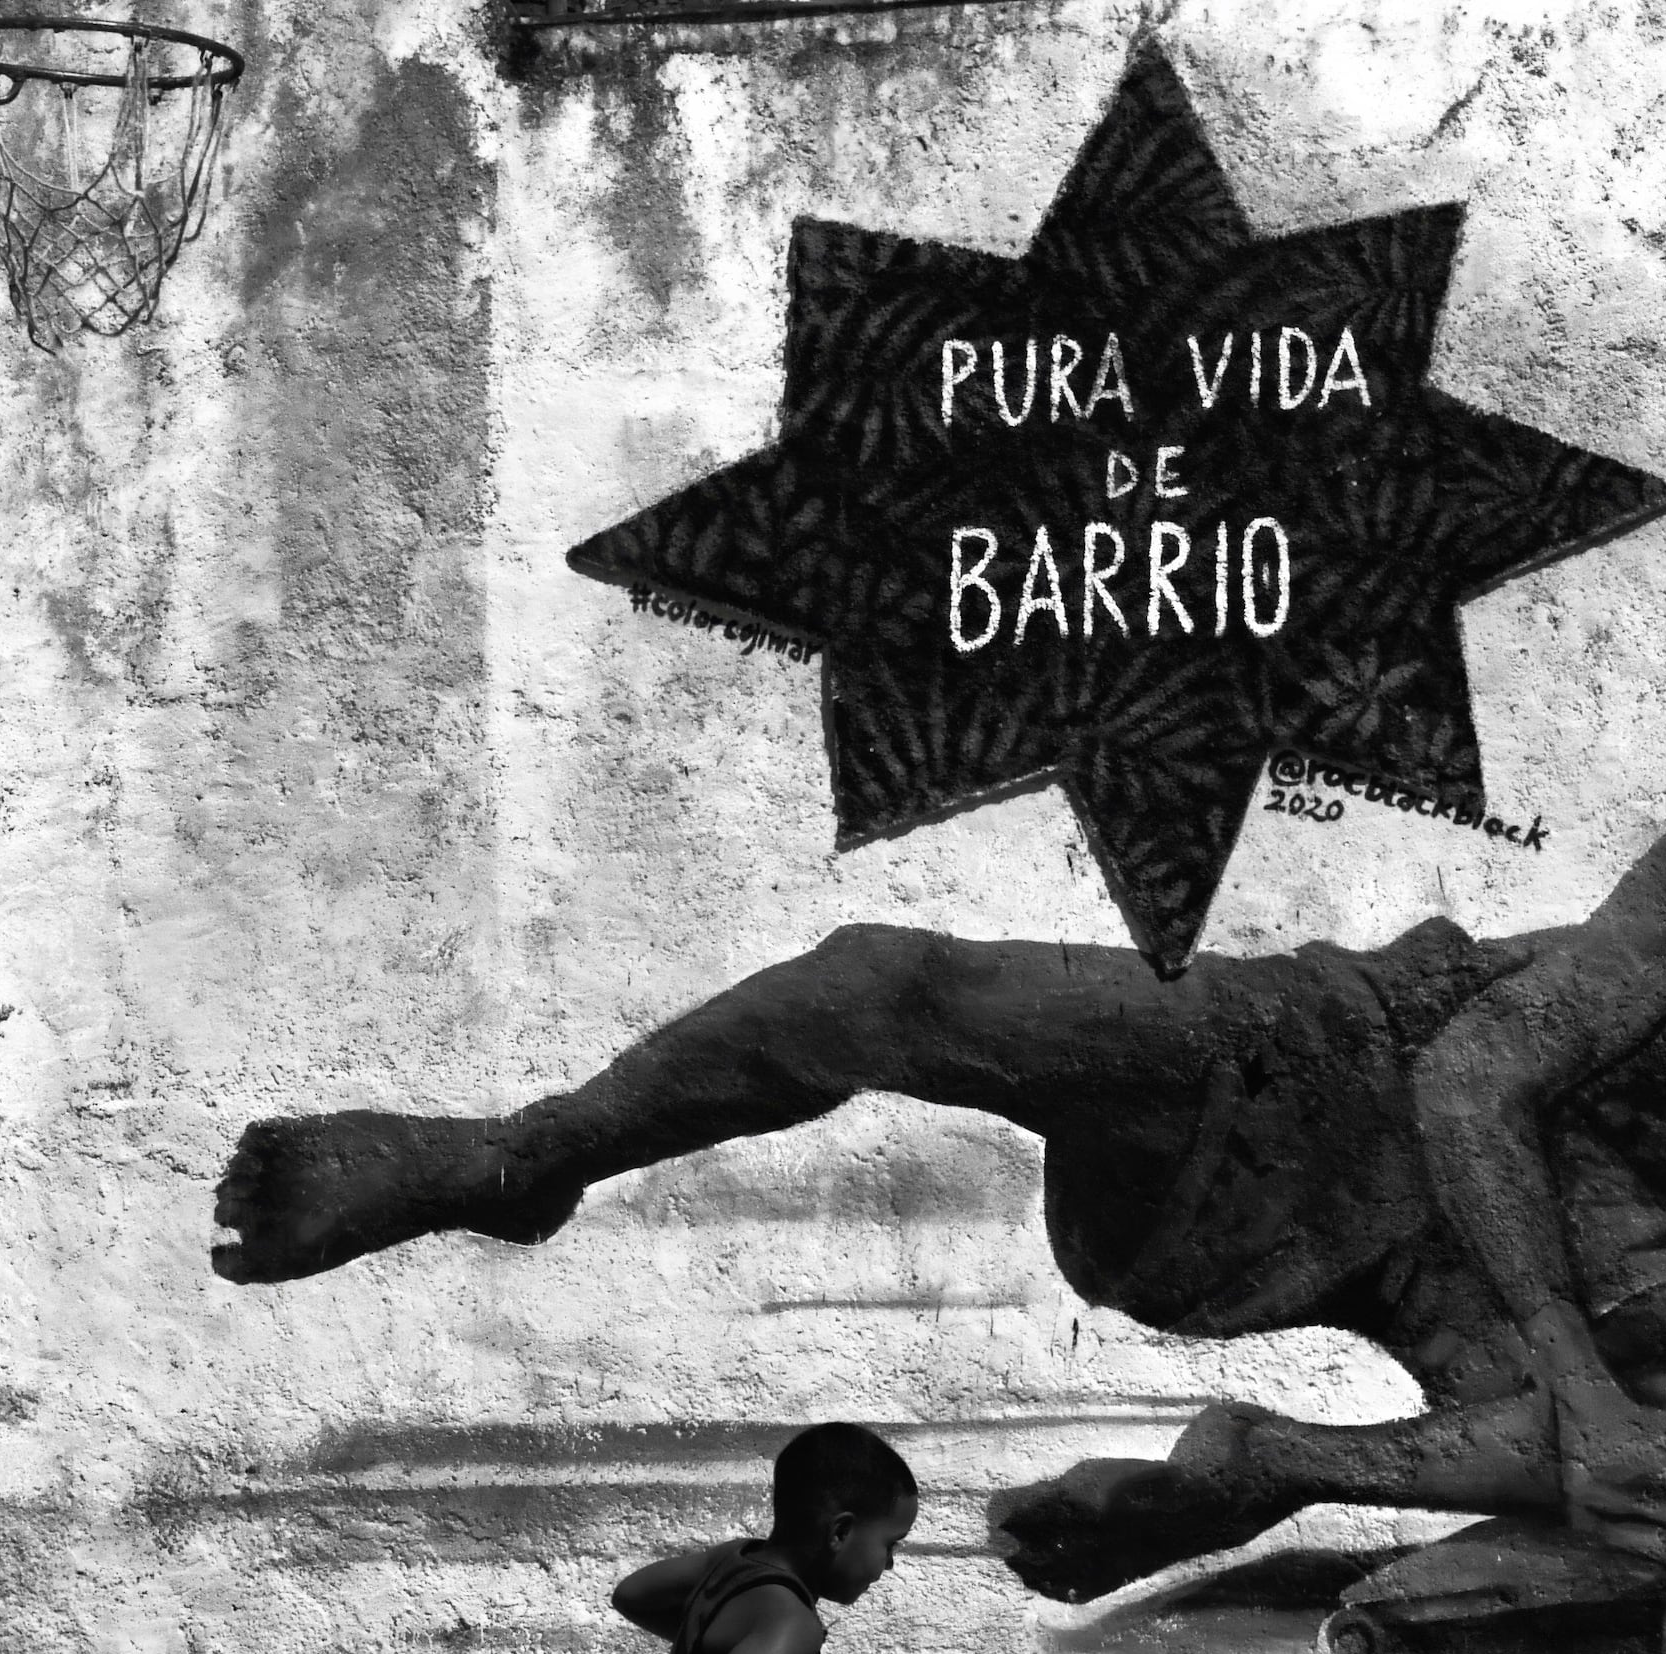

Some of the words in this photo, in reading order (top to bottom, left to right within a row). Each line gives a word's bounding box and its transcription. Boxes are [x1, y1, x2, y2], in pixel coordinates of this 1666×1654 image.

[941, 332, 1134, 427] PURA
[1188, 326, 1371, 411] VIDA
[1107, 445, 1190, 500] DE
[949, 516, 1290, 653] BARRIO
[1263, 789, 1345, 823] 2020
